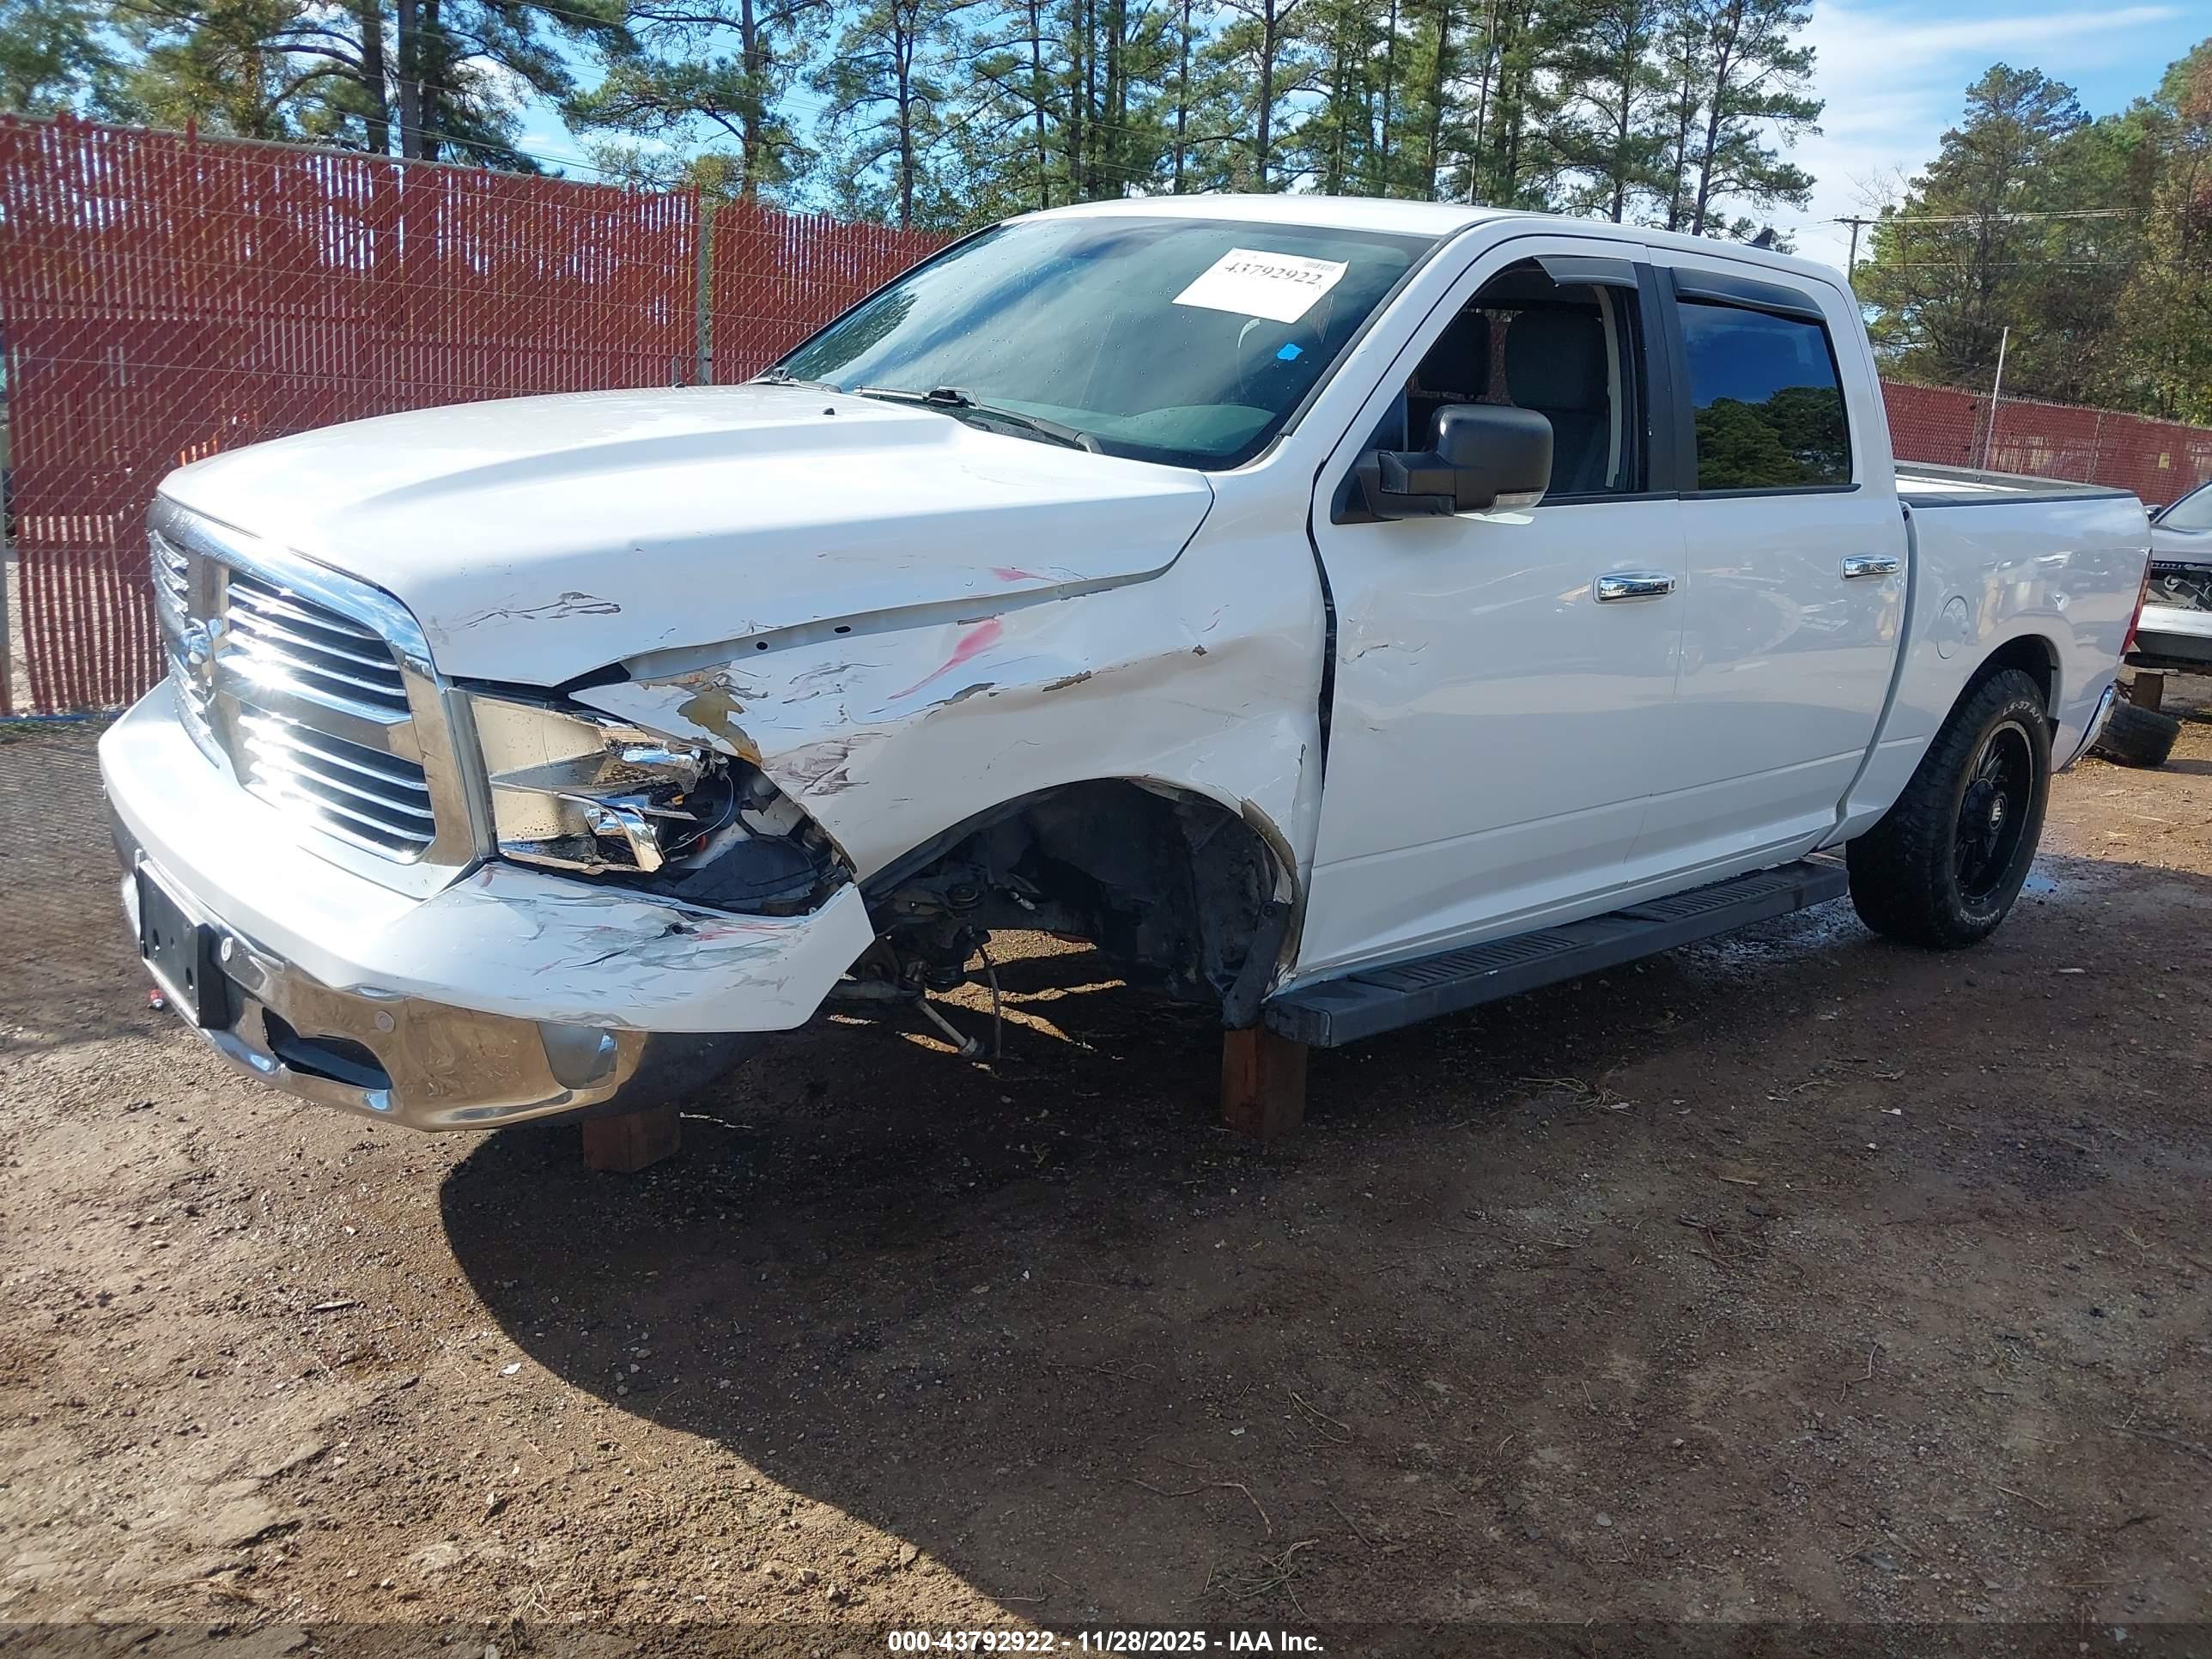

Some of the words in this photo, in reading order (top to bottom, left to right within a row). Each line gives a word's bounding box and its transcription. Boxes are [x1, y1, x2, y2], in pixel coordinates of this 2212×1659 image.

[1224, 262, 1322, 284] 43792922
[2002, 701, 2030, 717] LS-37
[2029, 707, 2043, 724] A/T
